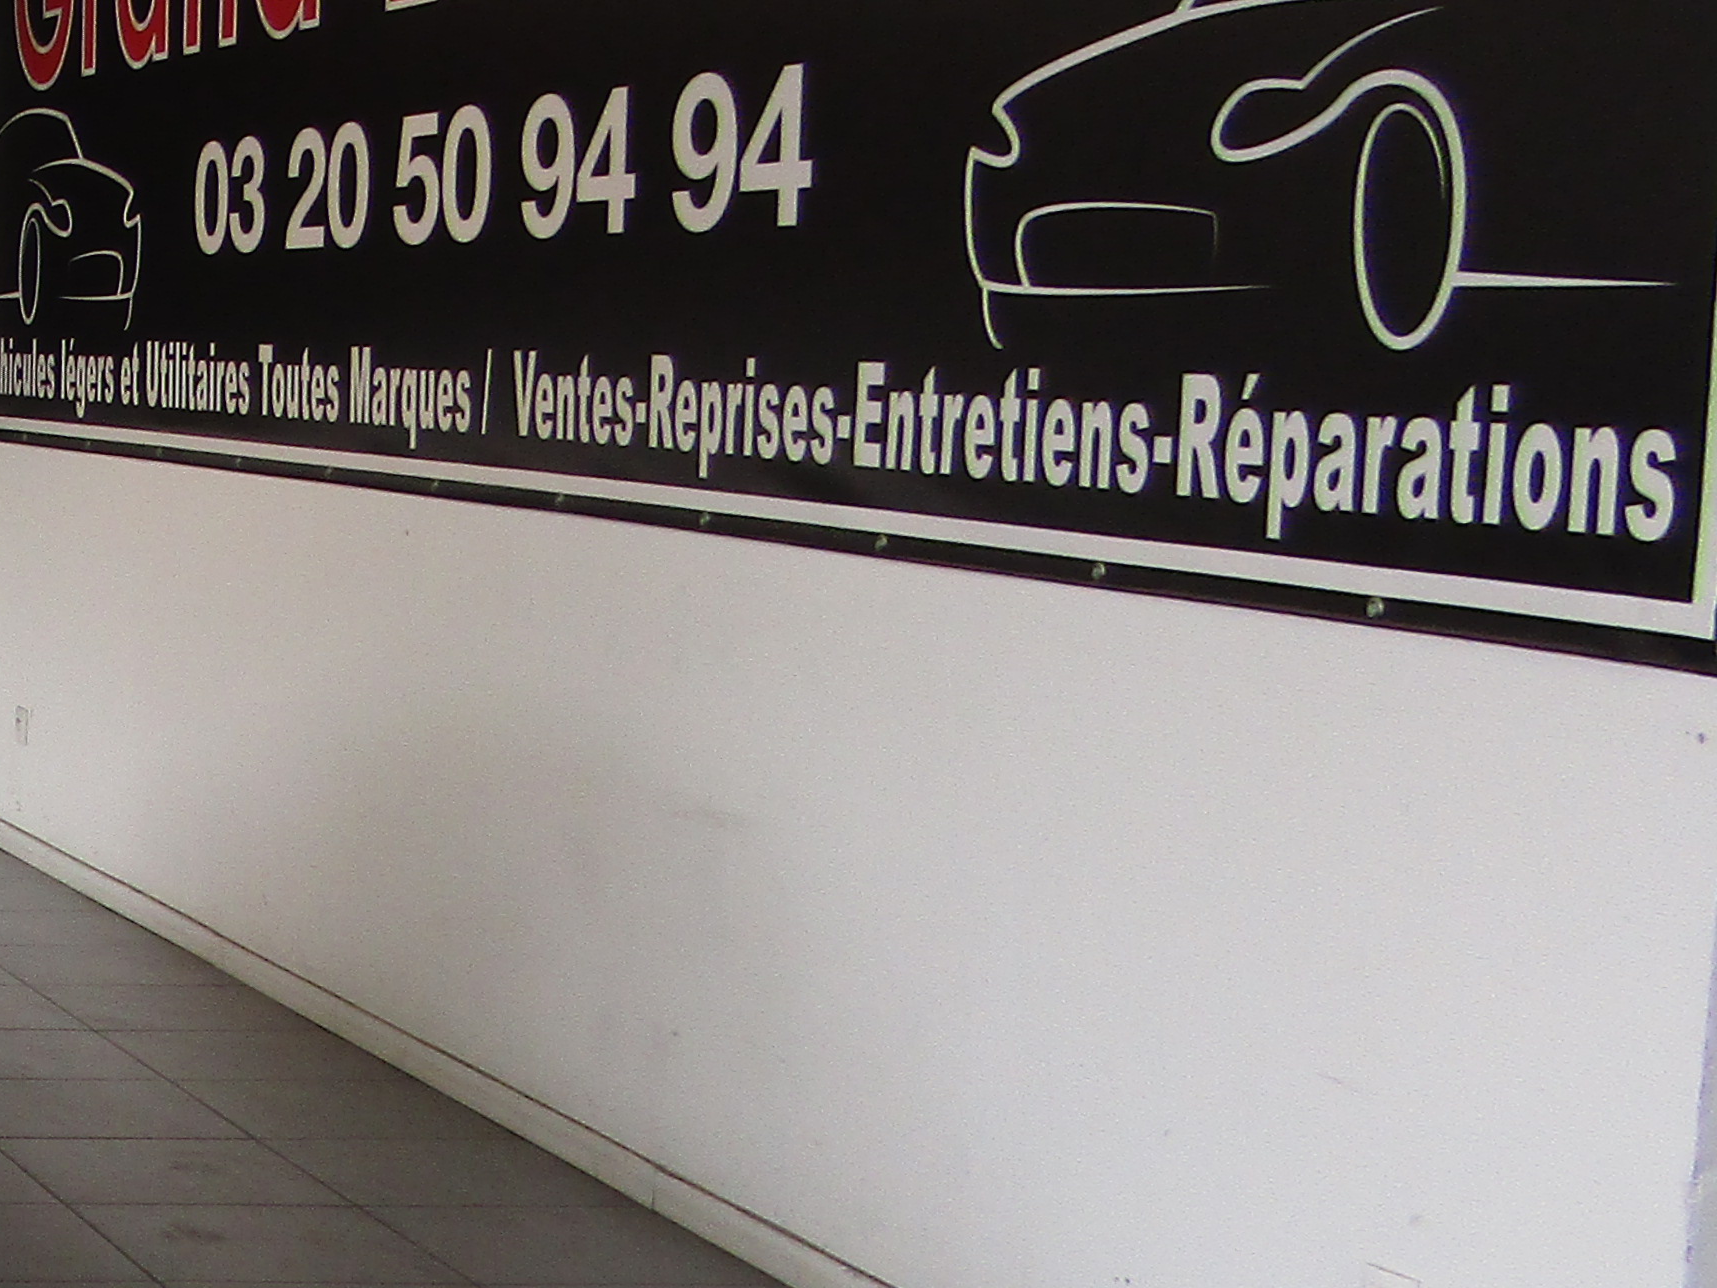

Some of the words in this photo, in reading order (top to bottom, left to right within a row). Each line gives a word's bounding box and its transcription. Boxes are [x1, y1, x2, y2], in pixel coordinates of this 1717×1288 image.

[195, 135, 266, 255] 03
[285, 121, 371, 250] 20
[393, 103, 492, 246] 50
[521, 86, 637, 240] 94
[671, 62, 814, 234] 94
[61, 337, 115, 418] légers
[120, 342, 139, 406] et
[145, 340, 250, 415] Utilitaires
[258, 343, 339, 423] Toutes
[349, 345, 471, 450] Marques
[480, 347, 493, 435] /
